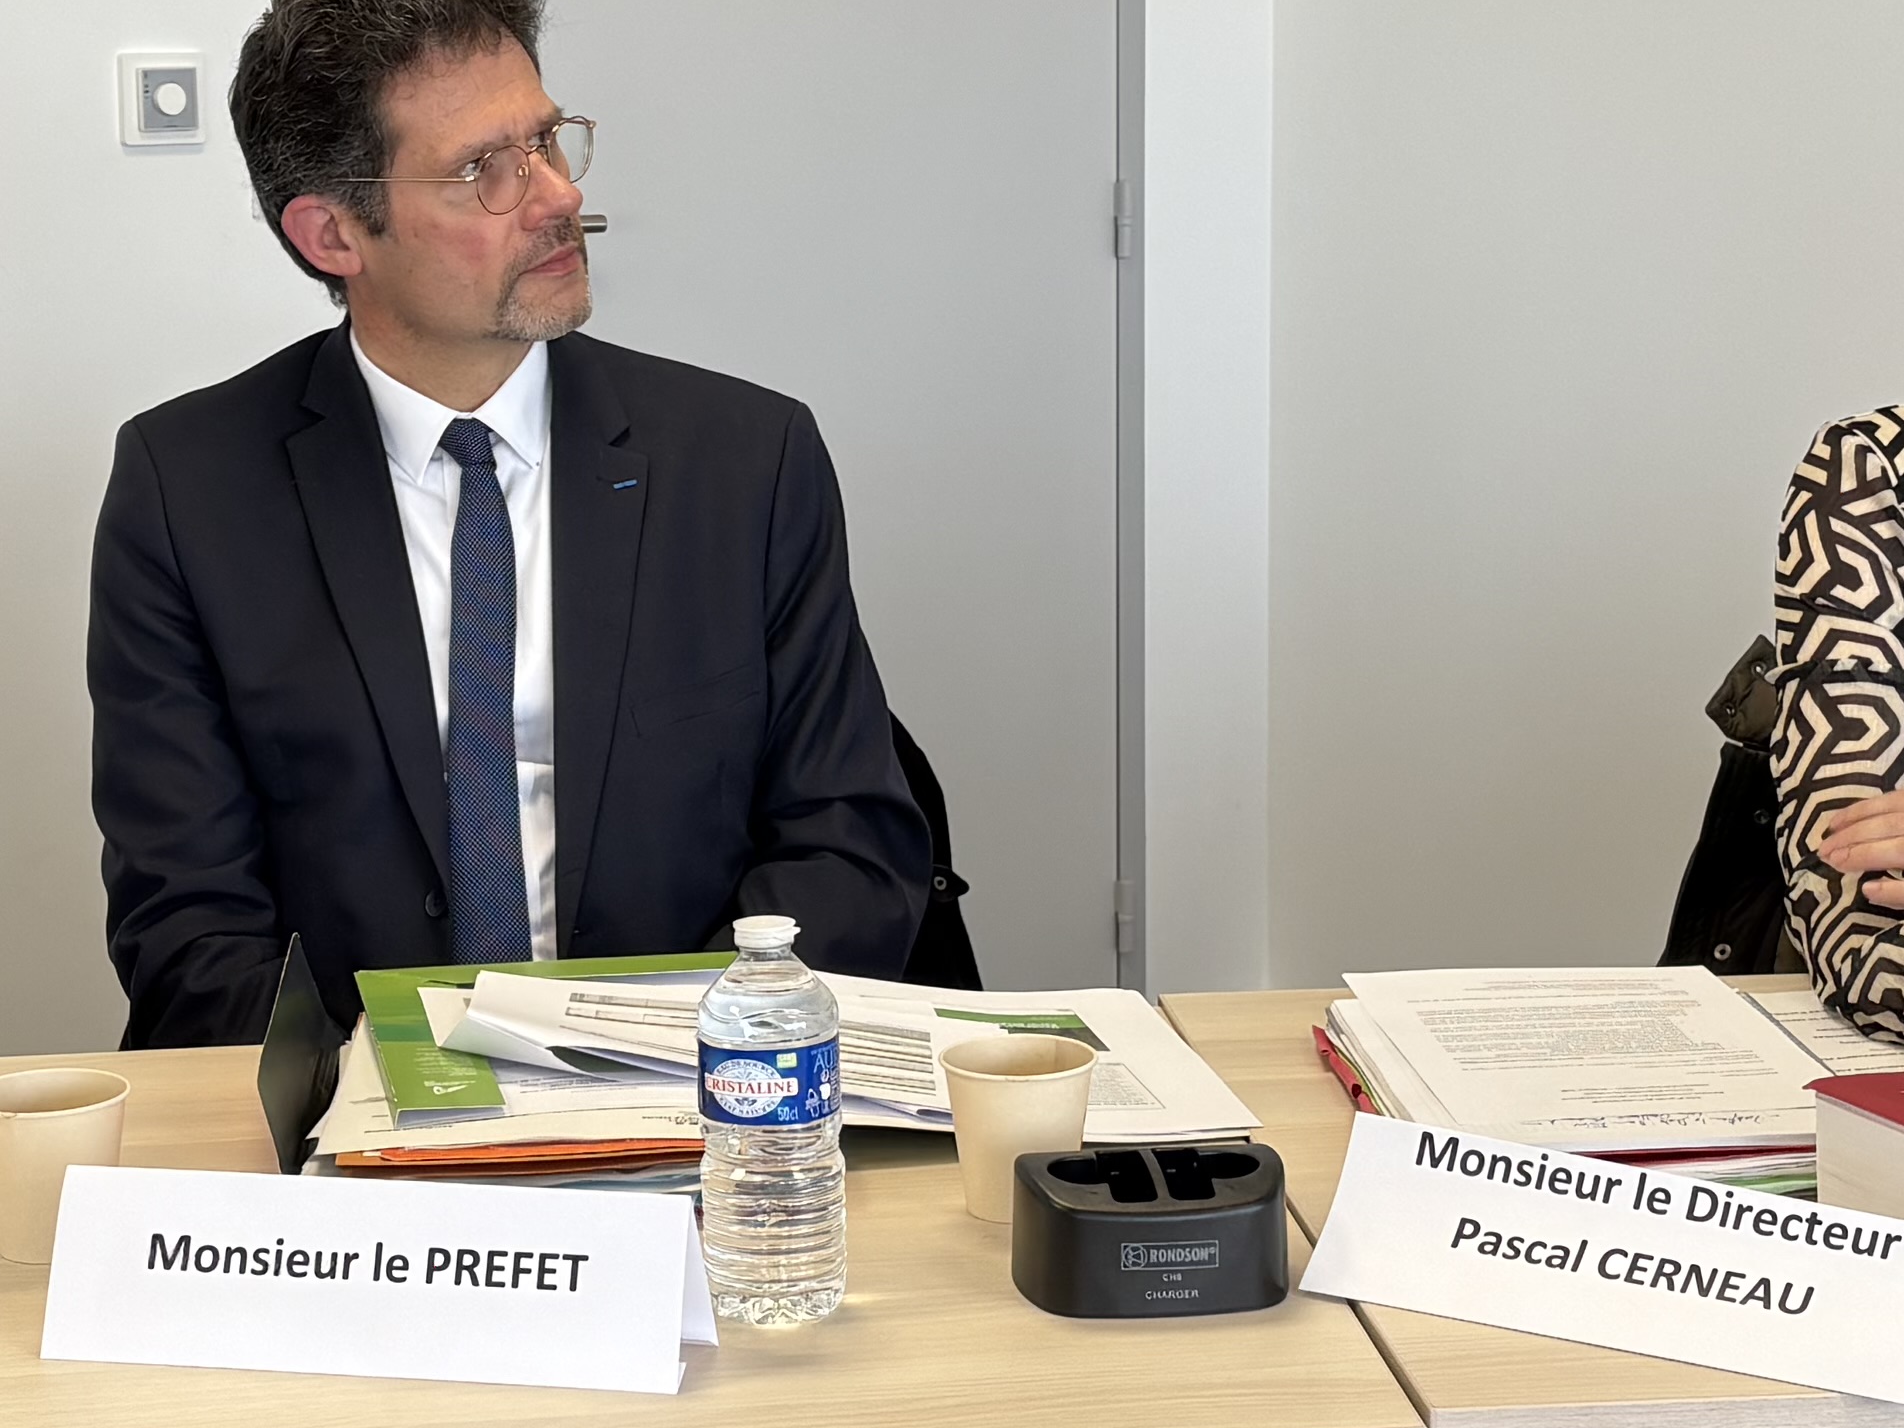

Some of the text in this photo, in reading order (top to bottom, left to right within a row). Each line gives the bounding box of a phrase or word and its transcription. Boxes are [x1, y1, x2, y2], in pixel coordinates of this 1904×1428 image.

[706, 1076, 795, 1095] CRISTALINE
[778, 1106, 799, 1122] 50cl
[1415, 1131, 1903, 1262] Monsieur le Directeur
[147, 1233, 589, 1292] Monsieur le PREFET
[1450, 1217, 1815, 1316] Pascal CERNEAU
[1145, 1289, 1199, 1300] CHARGER
